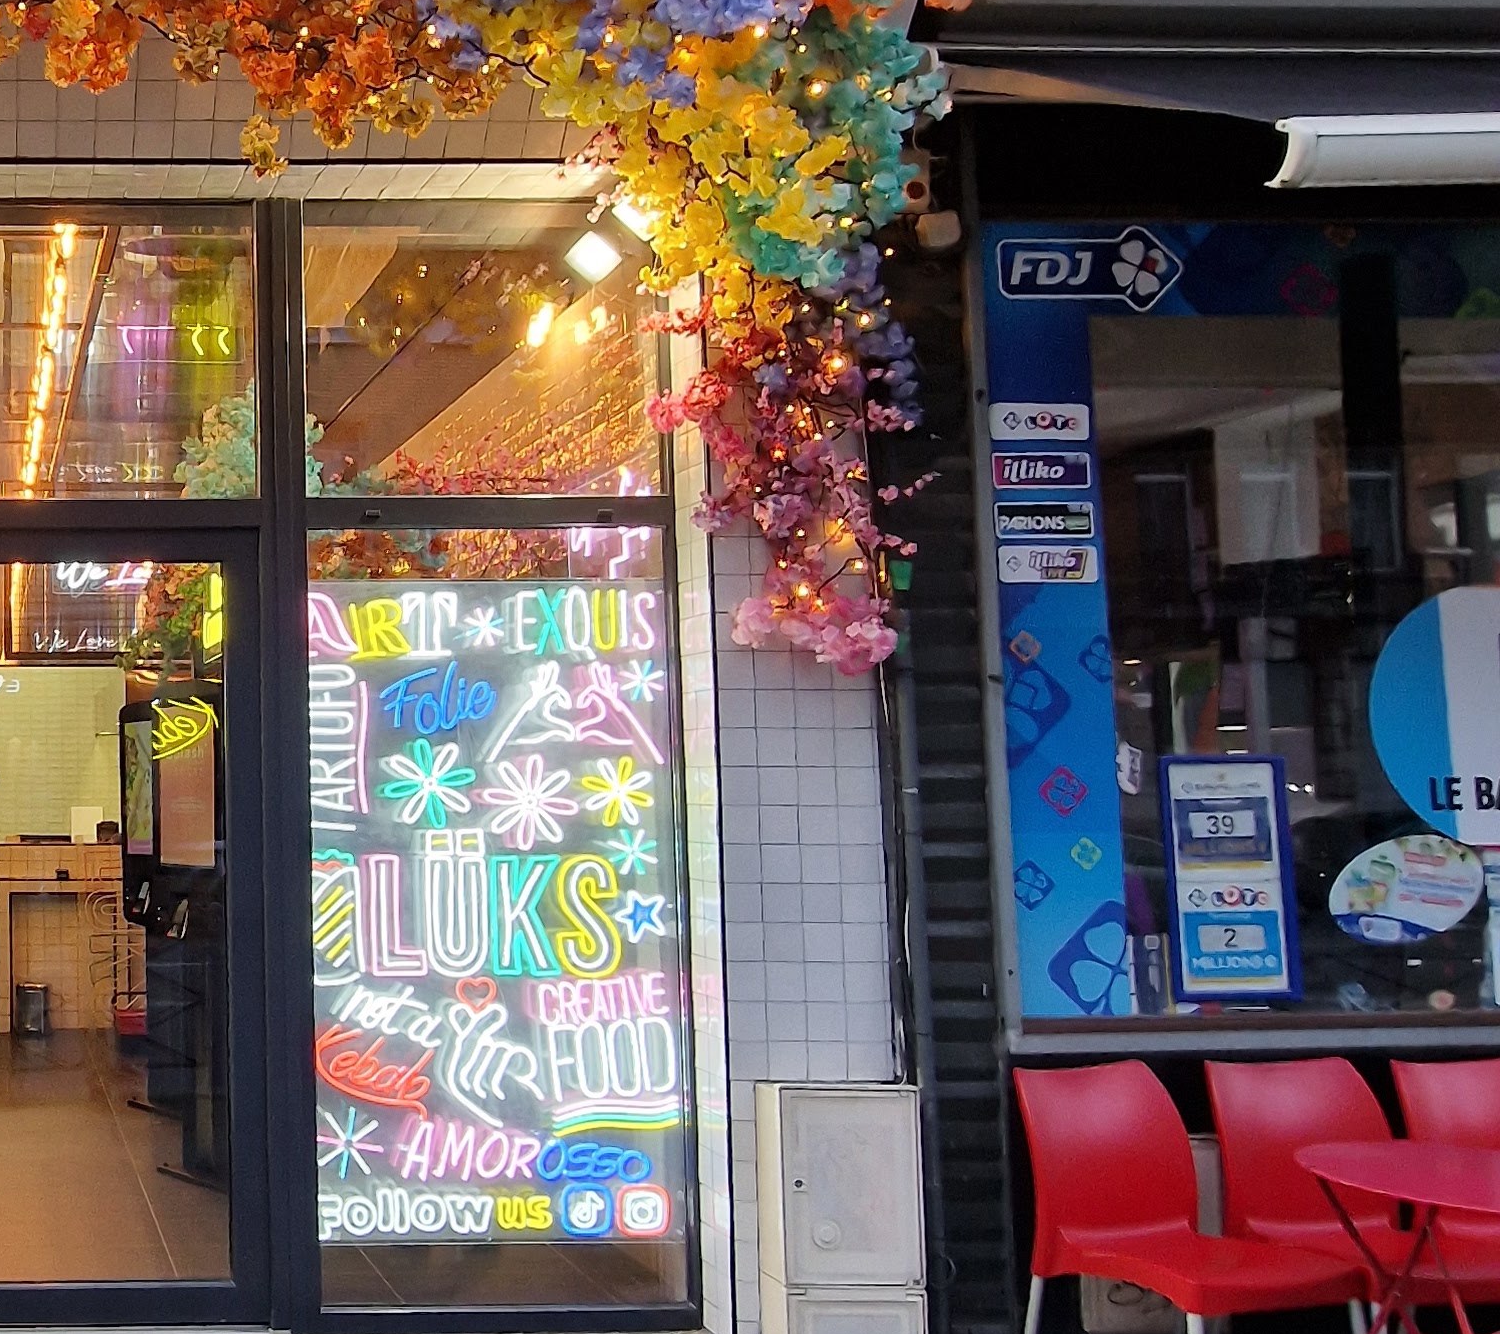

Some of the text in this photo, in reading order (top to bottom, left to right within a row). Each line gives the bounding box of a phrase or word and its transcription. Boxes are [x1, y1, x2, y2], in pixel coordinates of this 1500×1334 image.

[1009, 249, 1093, 286] FDJ
[1002, 457, 1066, 483] illiko
[999, 515, 1066, 531] PARIONS
[308, 591, 458, 661] ART
[512, 586, 657, 660] EXQUIS
[379, 660, 498, 735] Folie
[1427, 776, 1500, 812] LE B
[1206, 813, 1235, 835] 39
[362, 828, 622, 978] LÜKS
[1223, 928, 1238, 948] 2
[340, 983, 443, 1049] not a
[536, 972, 671, 1027] CREATIVE
[548, 1016, 678, 1102] FOOD
